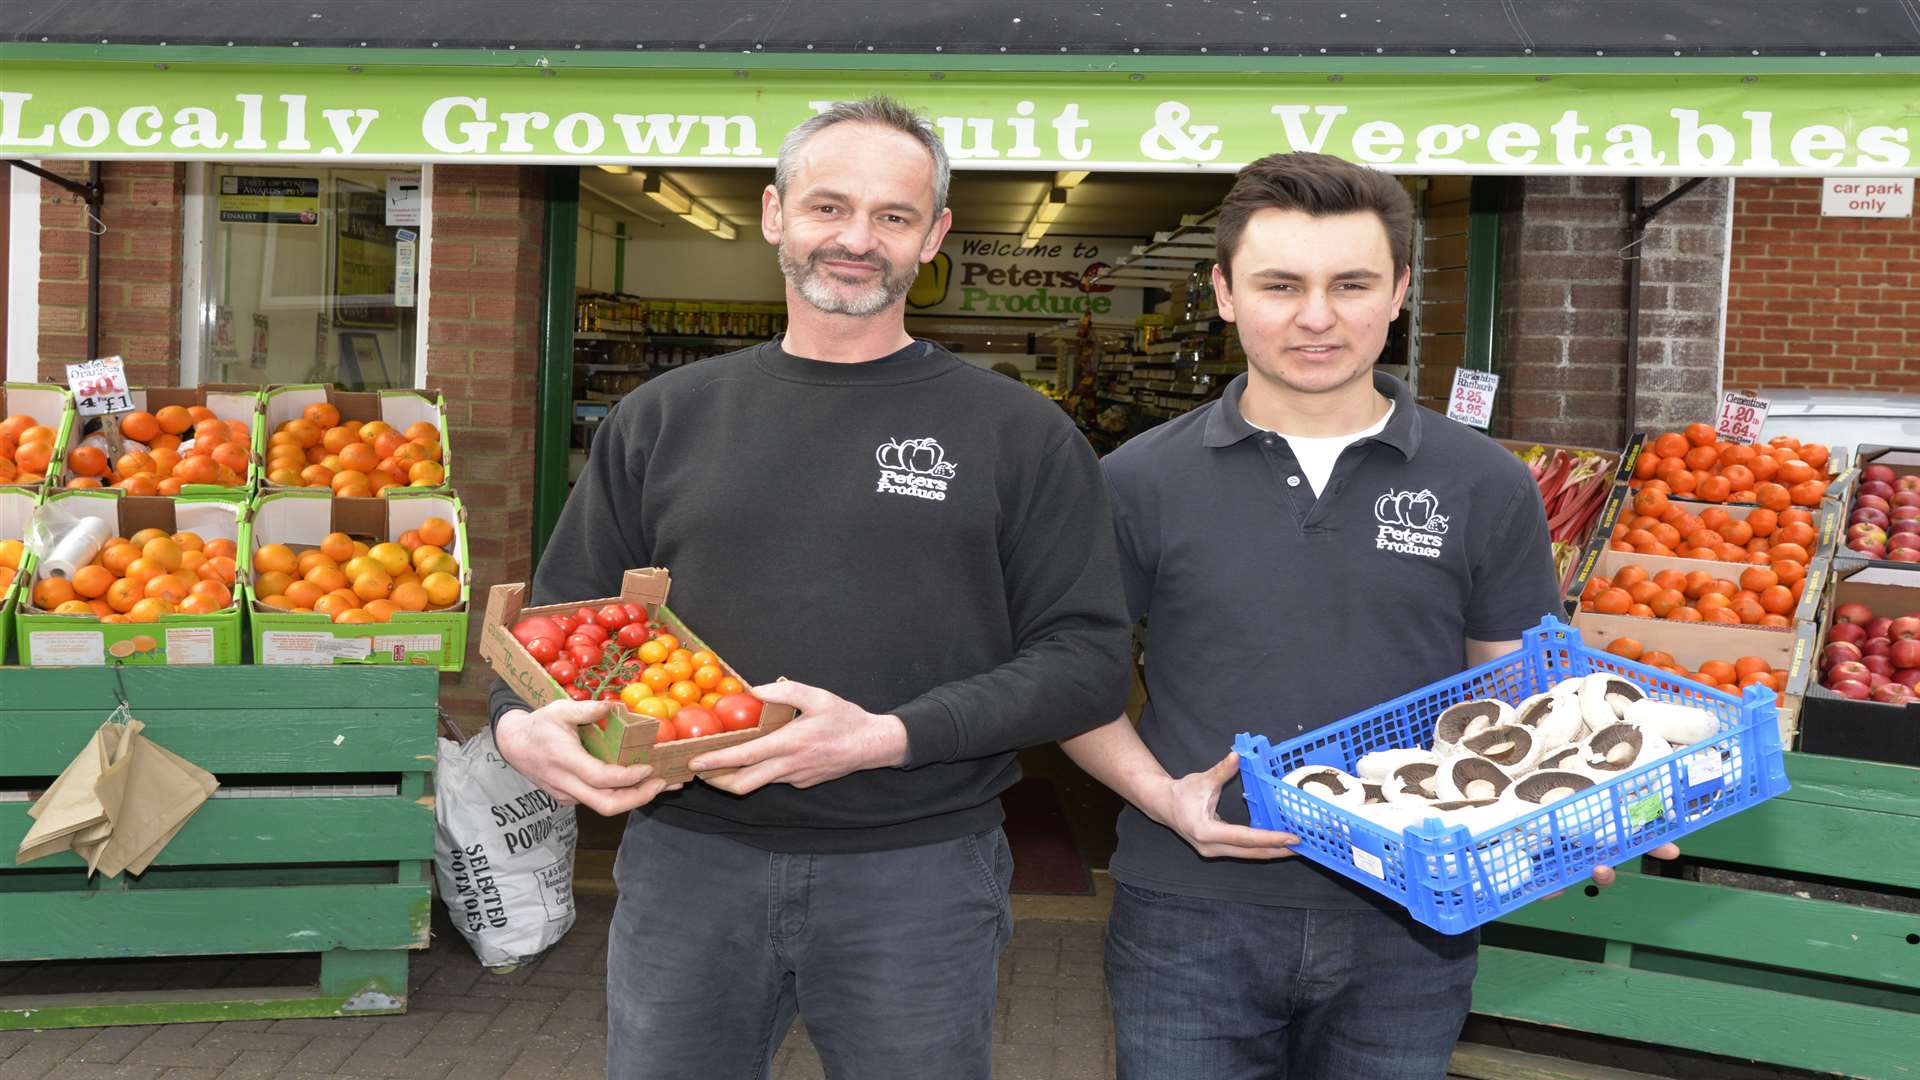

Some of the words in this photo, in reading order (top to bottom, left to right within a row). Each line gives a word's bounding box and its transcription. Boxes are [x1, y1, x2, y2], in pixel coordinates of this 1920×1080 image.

[0, 91, 380, 155] Locally
[422, 96, 762, 156] Grown
[1139, 100, 1223, 161] &
[1271, 104, 1911, 168] Vegetables
[1833, 183, 1860, 194] car
[1865, 183, 1904, 197] park
[1848, 198, 1886, 213] only
[961, 239, 1062, 258] Welcome
[1072, 242, 1099, 259] to
[959, 262, 1080, 288] Peters
[958, 287, 1112, 315] Produce
[1457, 378, 1493, 392] Rhubarb
[1726, 393, 1767, 410] Clementines
[880, 470, 947, 491] Peters
[876, 481, 946, 501] Produce
[1377, 525, 1443, 547] Peters
[1375, 538, 1441, 558] Produce
[451, 848, 487, 932] POTATOES
[465, 843, 508, 929] SELECTED
